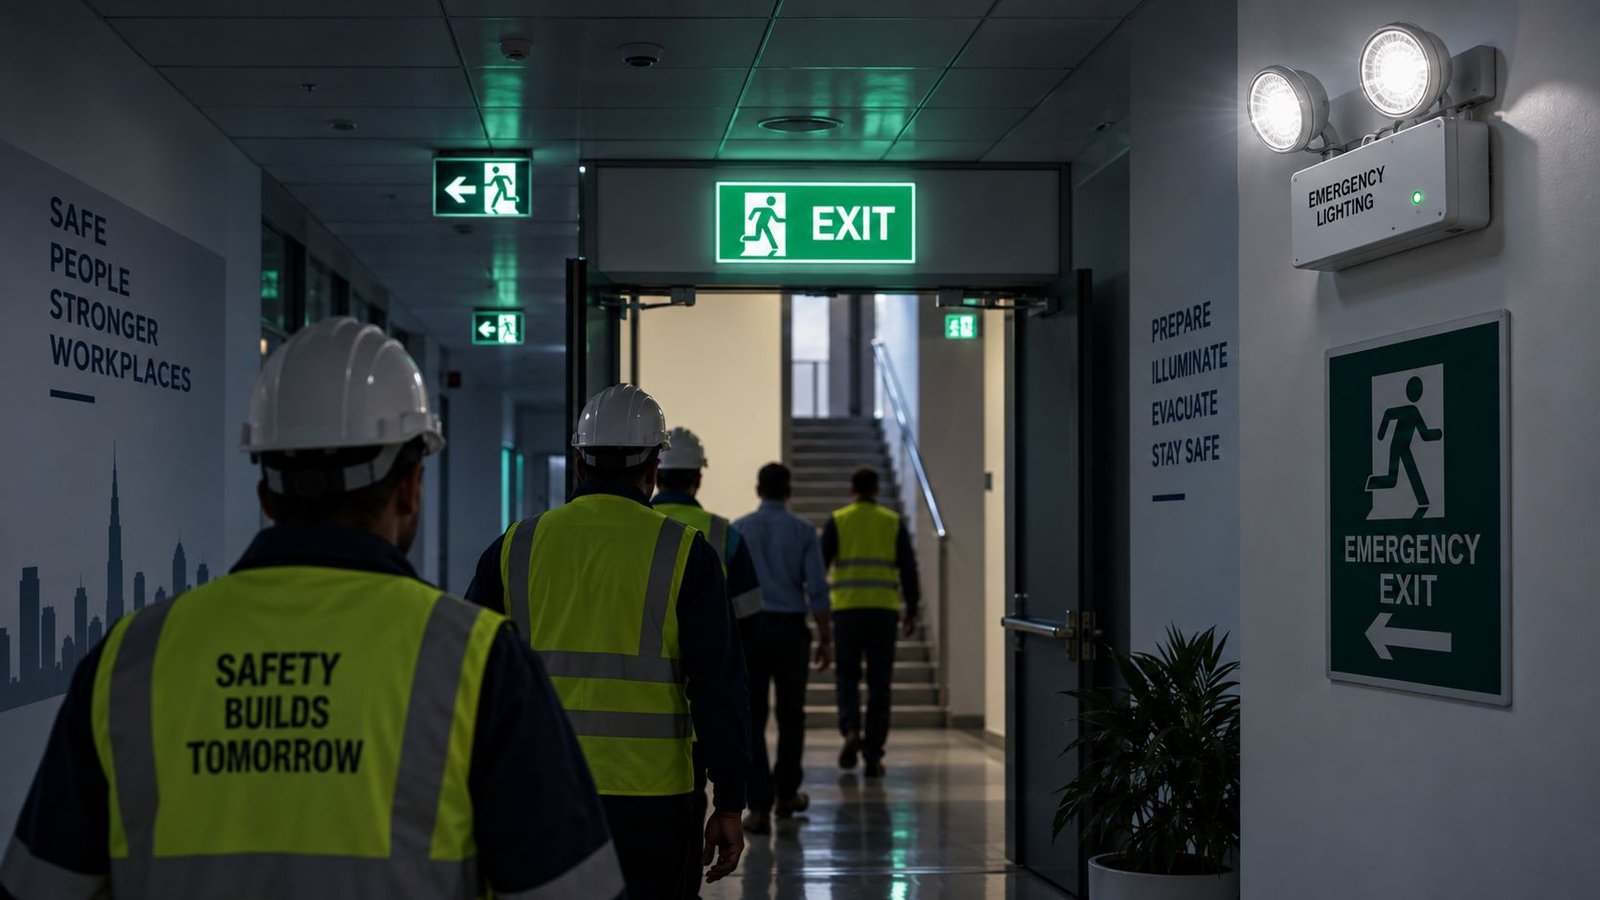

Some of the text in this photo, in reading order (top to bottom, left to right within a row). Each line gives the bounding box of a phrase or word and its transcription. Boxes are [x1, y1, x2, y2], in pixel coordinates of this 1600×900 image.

[1308, 165, 1385, 208] EMERGENCY
[50, 196, 106, 246] SAFE
[813, 206, 895, 240] EXIT
[1316, 193, 1374, 226] LIGHTING
[51, 242, 129, 296] PEOPLE
[50, 289, 158, 346] STRONGER
[1152, 301, 1210, 343] PREPARE
[50, 334, 191, 392] WORKPLACES
[1152, 342, 1227, 384] ILLUMINATE
[1152, 389, 1217, 426] EVACUATE
[1152, 434, 1219, 467] STAY SAFE
[1345, 534, 1480, 564] EMERGENCY
[1380, 573, 1437, 606] EXIT
[216, 652, 341, 688] SAFETY
[225, 695, 329, 729] BUILDS
[187, 738, 363, 774] TOMORROW
